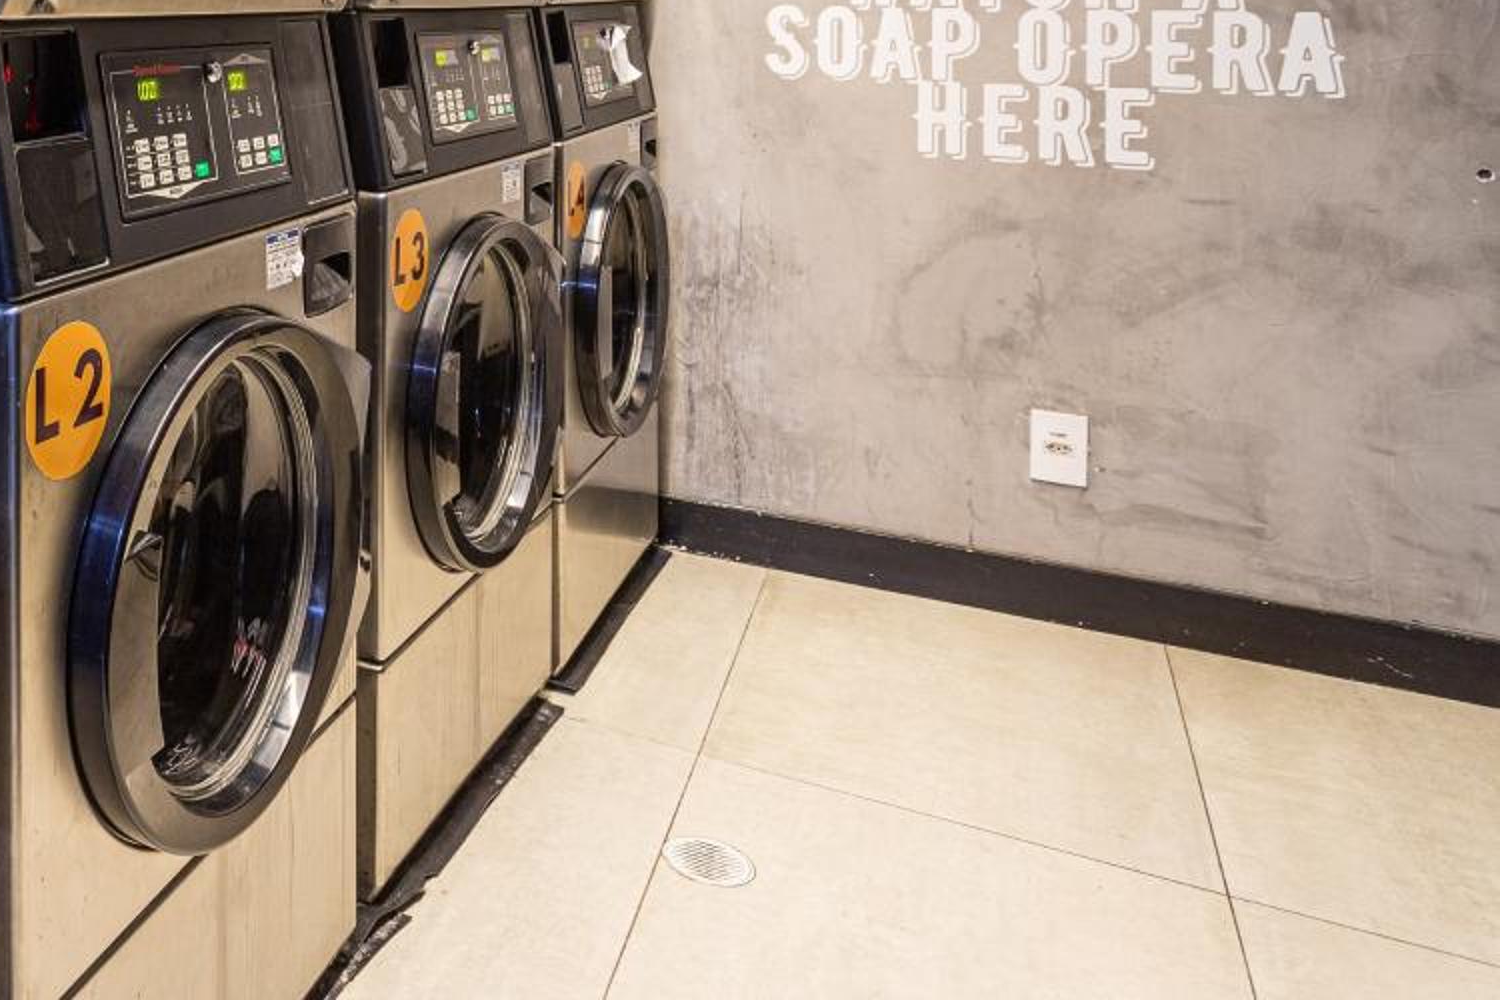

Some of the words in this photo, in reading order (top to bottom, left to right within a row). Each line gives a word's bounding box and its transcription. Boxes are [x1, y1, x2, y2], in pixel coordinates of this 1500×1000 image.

[765, 5, 981, 84] SOAP
[1013, 8, 1347, 99] OPERA
[913, 80, 1157, 171] HERE
[393, 231, 425, 286] L3
[34, 348, 104, 446] L2
